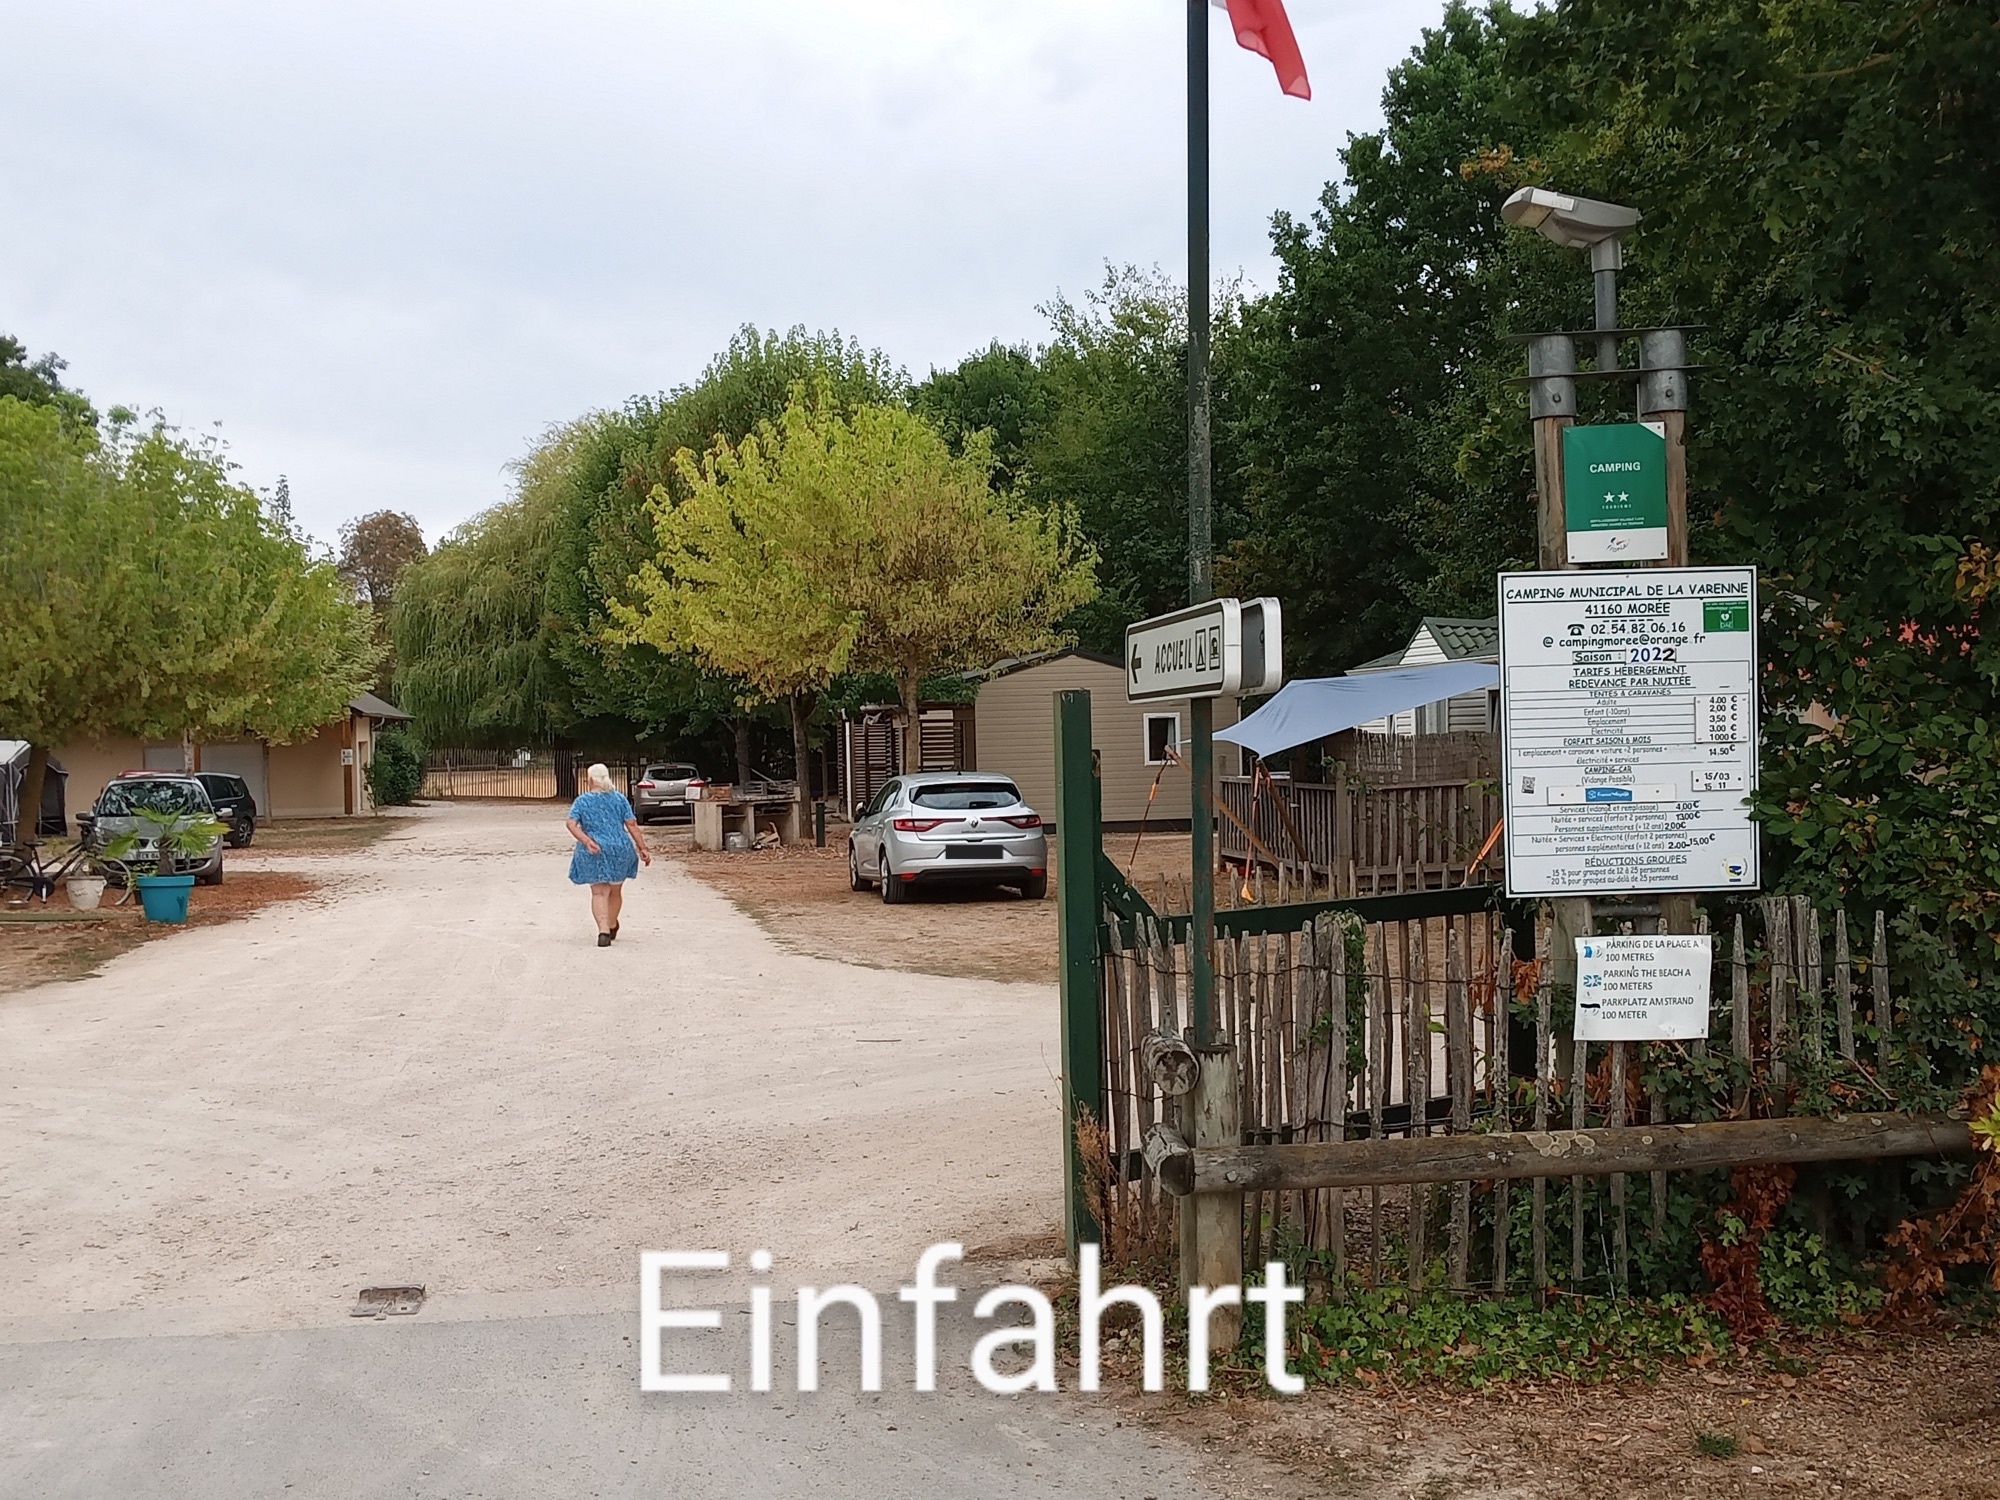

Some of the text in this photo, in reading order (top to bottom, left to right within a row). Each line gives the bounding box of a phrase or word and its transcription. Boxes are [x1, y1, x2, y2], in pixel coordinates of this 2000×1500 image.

[1589, 461, 1641, 473] CAMPING
[1506, 582, 1748, 599] CAMPING MUNICIPAL DE LA VARENNE
[1585, 599, 1670, 615] 41160 MORÉE
[1590, 622, 1686, 635] 02.54.82.06.16
[1559, 633, 1706, 650] campingmoree@orange.fr
[1154, 638, 1193, 674] ACCUEIL
[1574, 651, 1612, 662] Saison
[1630, 646, 1676, 662] 2022
[1573, 667, 1611, 677] TARIFS
[1630, 676, 1649, 687] PAR
[1589, 689, 1618, 698] TENTES
[1628, 688, 1672, 697] CARAVANES
[1583, 708, 1605, 716] Enfant
[1587, 718, 1627, 727] Emplacement
[1563, 737, 1594, 746] FORFAIT
[1596, 736, 1624, 745] SAISON
[1632, 735, 1652, 744] MOIS
[1522, 749, 1562, 758] emplacement
[1600, 747, 1622, 755] voiture
[1632, 746, 1663, 755] personnes
[1584, 765, 1633, 774] CAMPING-CAR
[1581, 776, 1607, 786] (Vidange
[1704, 772, 1730, 781] 15/03
[1559, 806, 1586, 814] Services
[1578, 815, 1603, 823] services
[1554, 825, 1585, 833] Personnes
[1558, 834, 1587, 843] Services
[1555, 844, 1586, 853] personnes
[1584, 854, 1688, 867] RÉDUCTIONS GROUPES
[1567, 869, 1582, 878] pour
[1582, 868, 1607, 877] groupes
[1607, 867, 1615, 875] de
[1616, 867, 1624, 875] 12
[1630, 866, 1639, 874] 25
[1639, 866, 1670, 876] personnes
[1567, 878, 1582, 887] pour
[1582, 877, 1607, 886] groupes
[1640, 874, 1648, 882] 25
[1648, 874, 1679, 883] personnes
[1606, 939, 1699, 950] PARKING DE LA PLAGE A
[1605, 952, 1655, 962] 100 METRES
[1603, 968, 1692, 978] PARKING THE BEACH A
[1603, 982, 1653, 991] 100 METERS
[1601, 997, 1648, 1006] PARKPLATZ
[1601, 1010, 1648, 1020] 100 METER
